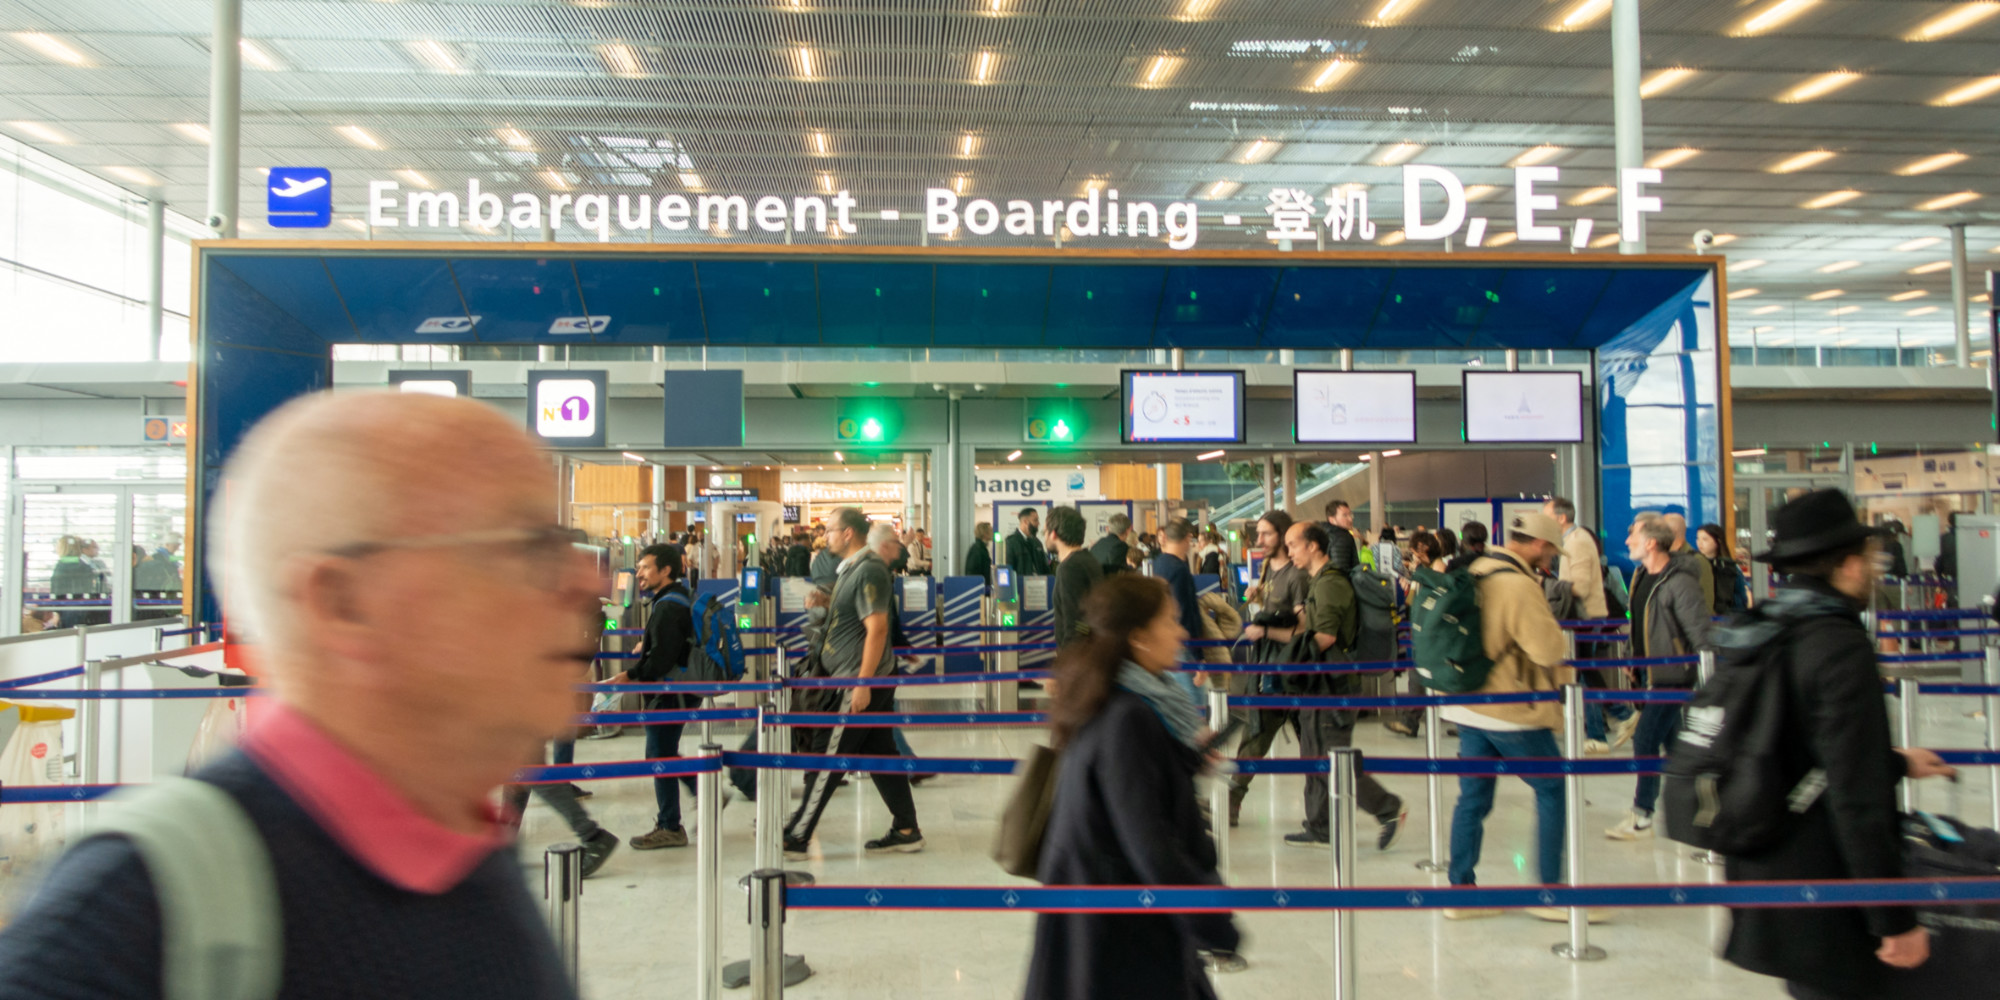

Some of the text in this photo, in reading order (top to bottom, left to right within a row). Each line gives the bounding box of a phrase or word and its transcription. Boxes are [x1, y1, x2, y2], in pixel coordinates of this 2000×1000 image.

[369, 164, 1663, 250] Embarquement - Boarding - 登机 D, E, F
[974, 475, 1051, 497] hange
